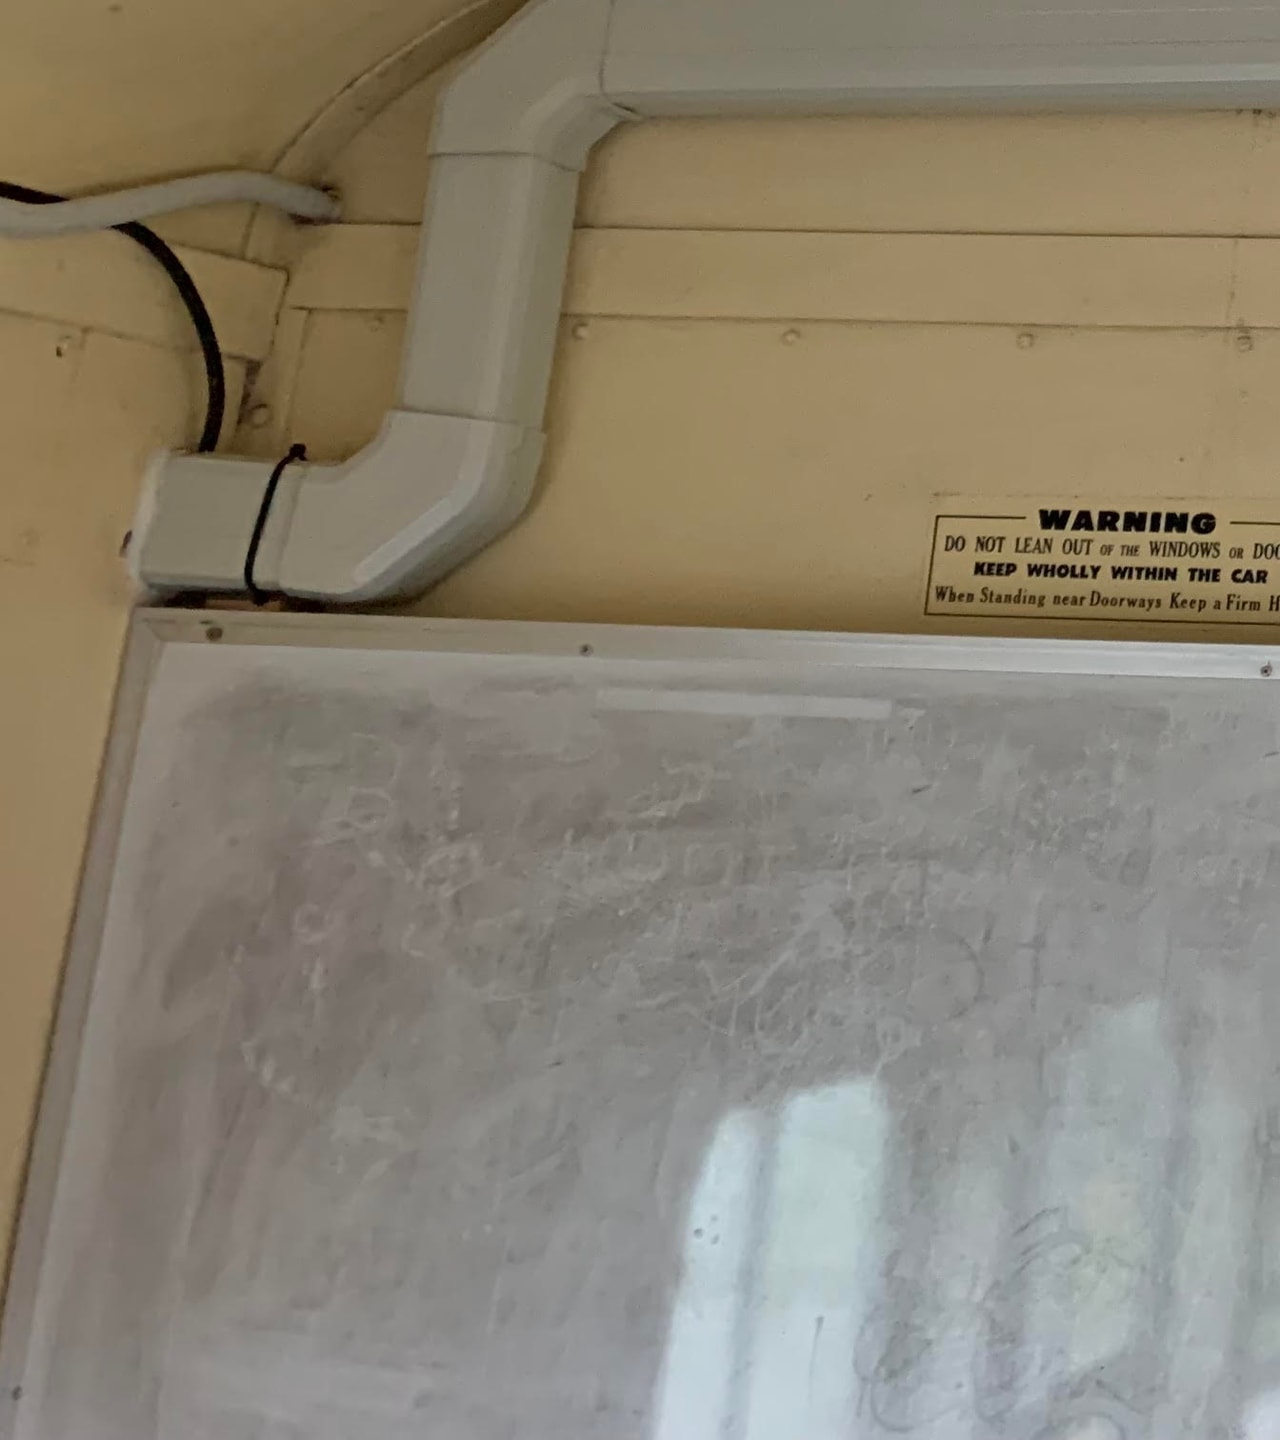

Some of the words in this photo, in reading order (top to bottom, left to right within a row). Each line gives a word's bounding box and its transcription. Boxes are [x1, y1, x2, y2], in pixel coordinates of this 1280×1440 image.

[1039, 509, 1216, 534] WARNING
[945, 535, 966, 552] DO
[975, 536, 1006, 553] NOT
[1015, 537, 1053, 554] LEAN
[1062, 539, 1093, 555] OUT
[1100, 544, 1114, 556] OF
[1121, 545, 1140, 556] THE
[1150, 541, 1220, 558] WINDOWS
[1229, 547, 1244, 559] OR
[974, 562, 1017, 576] KEEP
[1027, 564, 1101, 579] WHOLLY
[1111, 566, 1177, 581] WITHIN
[1188, 568, 1221, 582] THE
[1231, 569, 1268, 584] CAR
[936, 586, 974, 603] When
[980, 587, 1046, 608] Standing
[1053, 594, 1086, 606] near
[1090, 590, 1161, 612] Doorways
[1169, 592, 1206, 613] Keep
[1213, 600, 1221, 610] a
[1226, 594, 1260, 611] Firm
